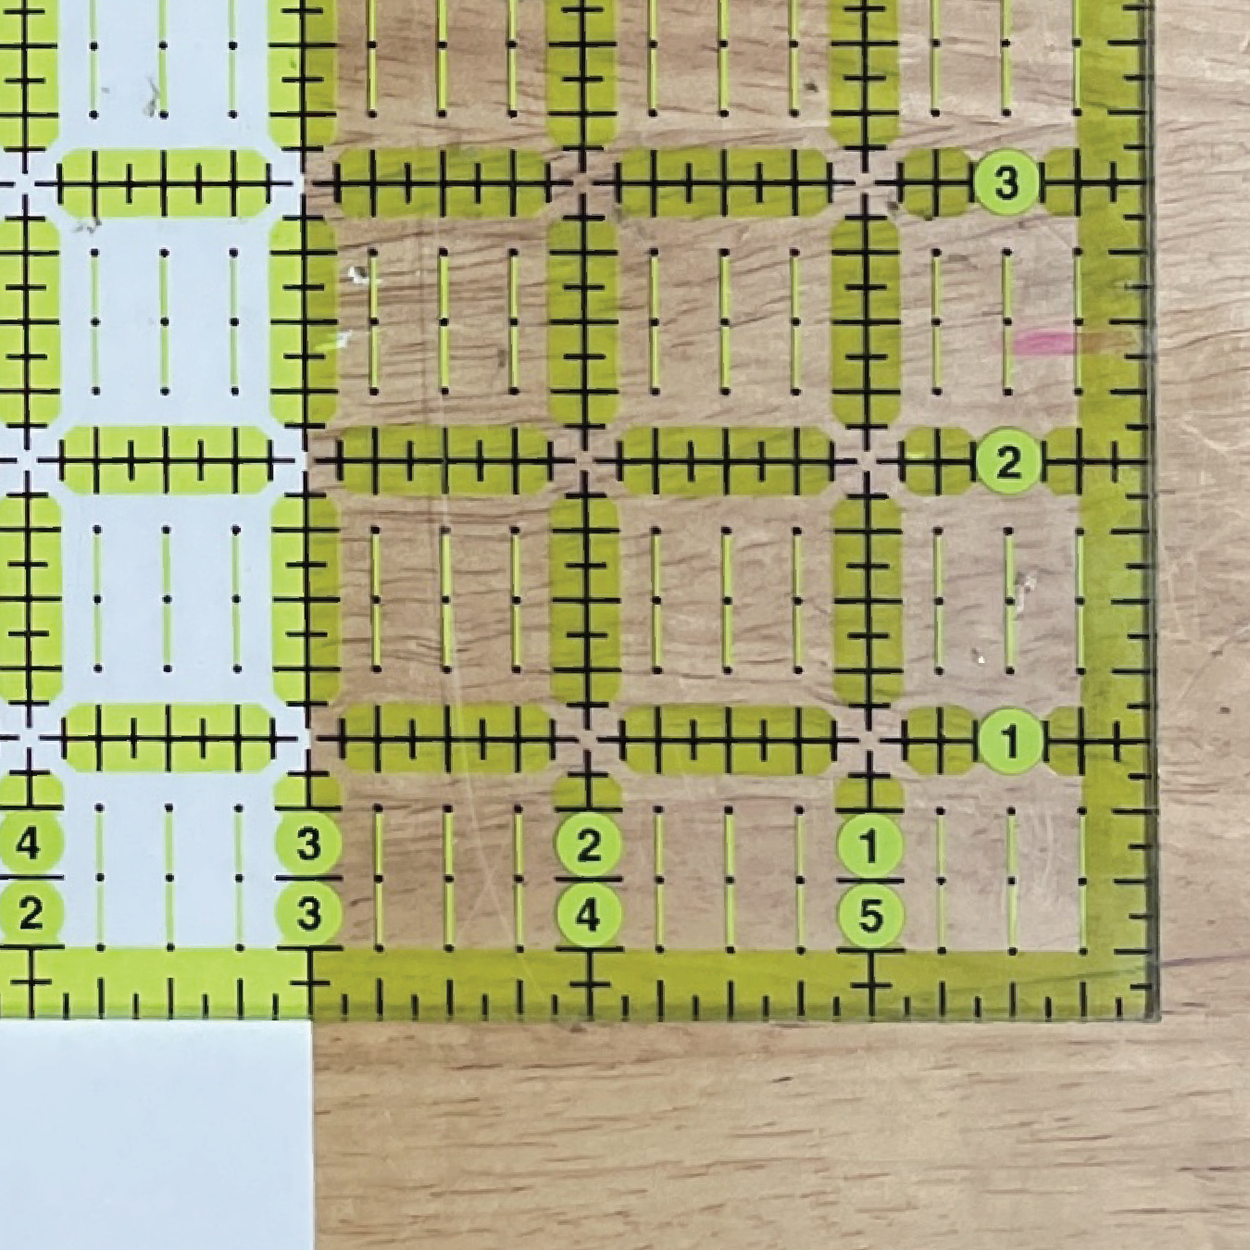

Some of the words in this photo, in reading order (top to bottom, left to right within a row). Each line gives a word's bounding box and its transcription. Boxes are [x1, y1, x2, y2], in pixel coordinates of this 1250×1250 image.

[995, 165, 1019, 201] 3
[996, 445, 1022, 480] 2
[1000, 724, 1017, 759] 1
[15, 826, 40, 860] 4
[297, 826, 321, 861] 3
[577, 828, 602, 863] 2
[859, 827, 876, 864] 1
[19, 895, 43, 930] 2
[297, 895, 322, 931] 3
[576, 896, 601, 932] 4
[859, 898, 884, 934] 5
